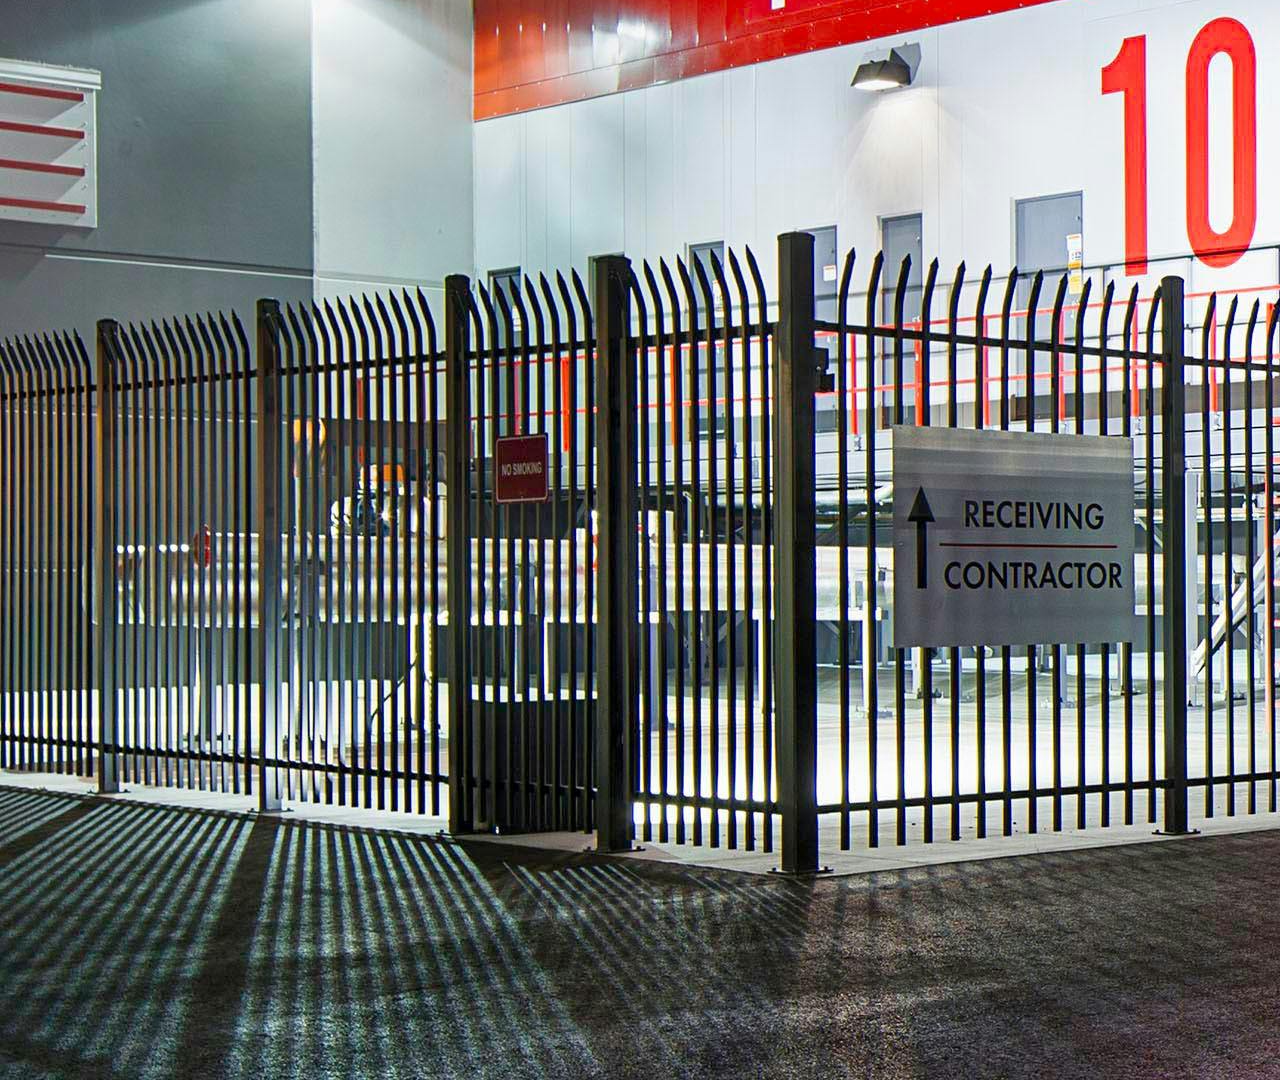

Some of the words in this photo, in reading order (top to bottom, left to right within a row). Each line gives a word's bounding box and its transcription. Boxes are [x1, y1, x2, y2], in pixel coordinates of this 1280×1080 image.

[501, 463, 512, 477] NO
[512, 461, 542, 476] SMOKING
[964, 500, 1104, 530] RECEIVING
[944, 561, 1122, 589] CONTRACTOR
